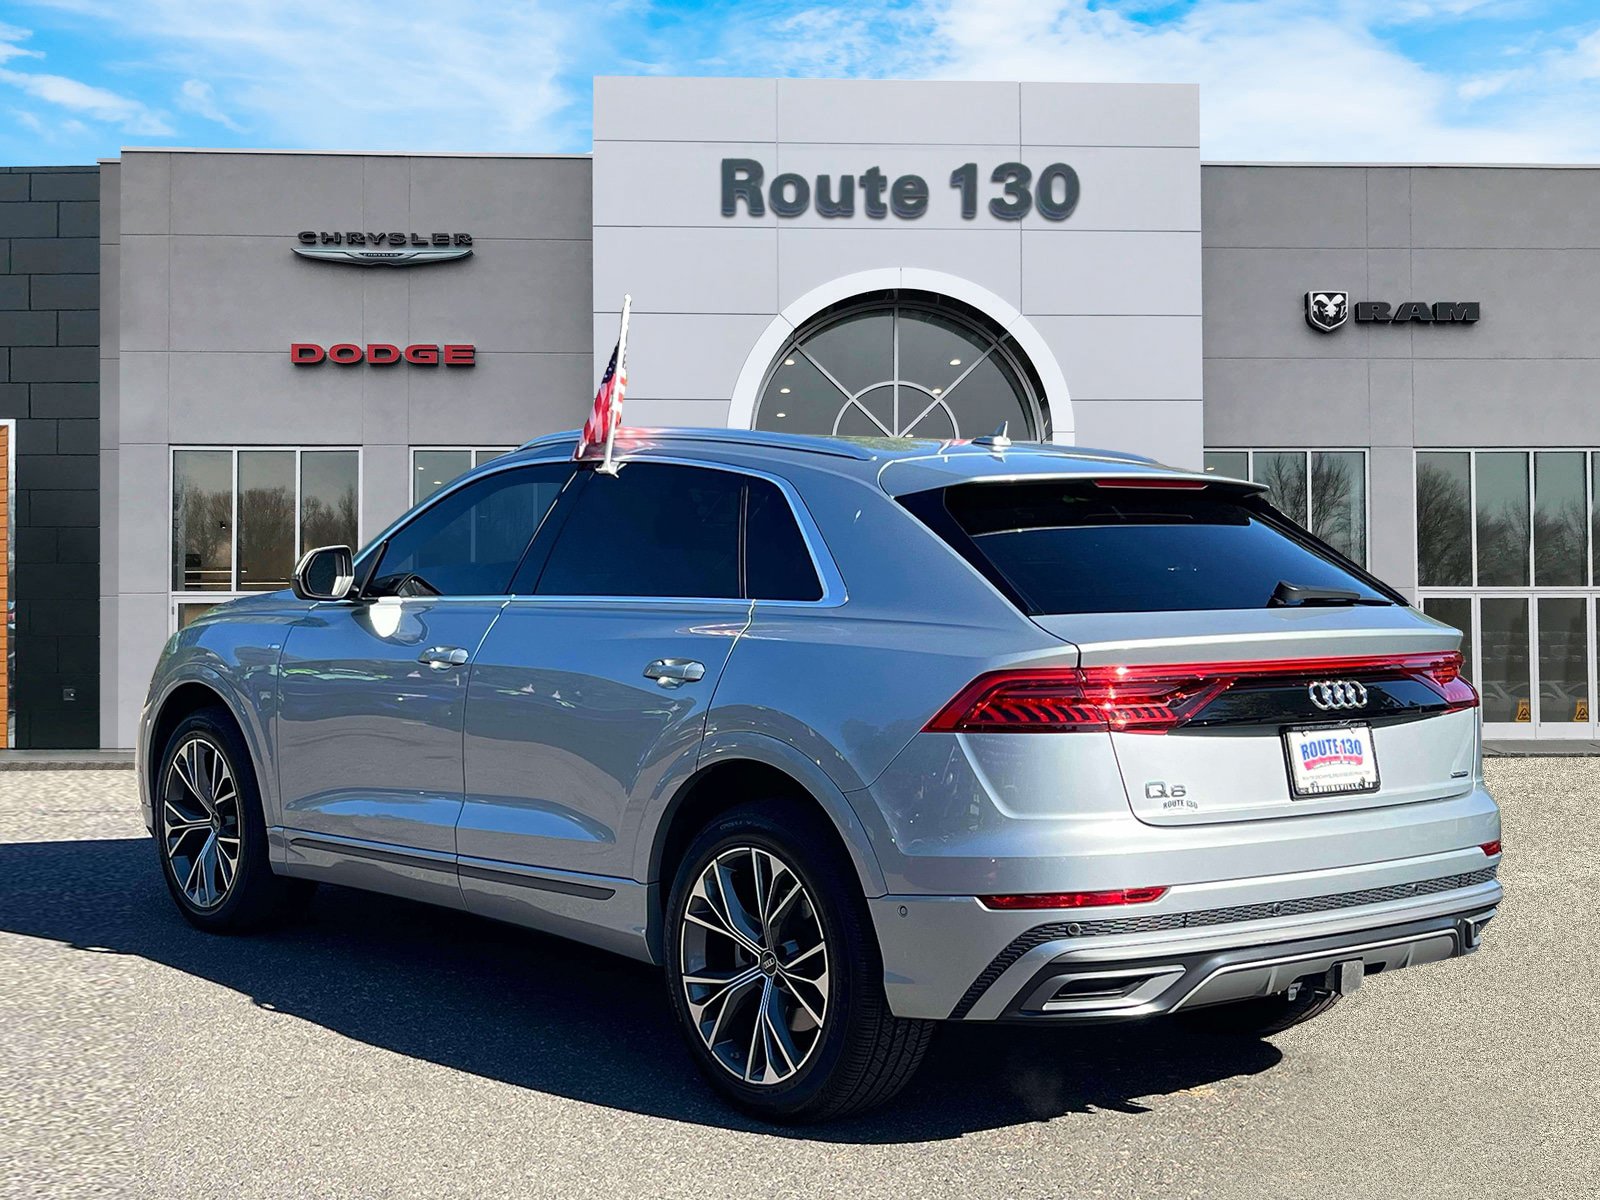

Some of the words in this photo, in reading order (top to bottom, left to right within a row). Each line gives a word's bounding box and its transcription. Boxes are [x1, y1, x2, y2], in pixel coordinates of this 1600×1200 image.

[721, 158, 929, 218] Route
[950, 162, 1080, 221] 130
[298, 231, 473, 246] CHRYSLER
[1355, 301, 1480, 324] RAM
[291, 343, 476, 365] DODGE
[1301, 738, 1339, 761] ROUTE
[1340, 738, 1363, 755] 130
[1163, 799, 1184, 809] ROUTE
